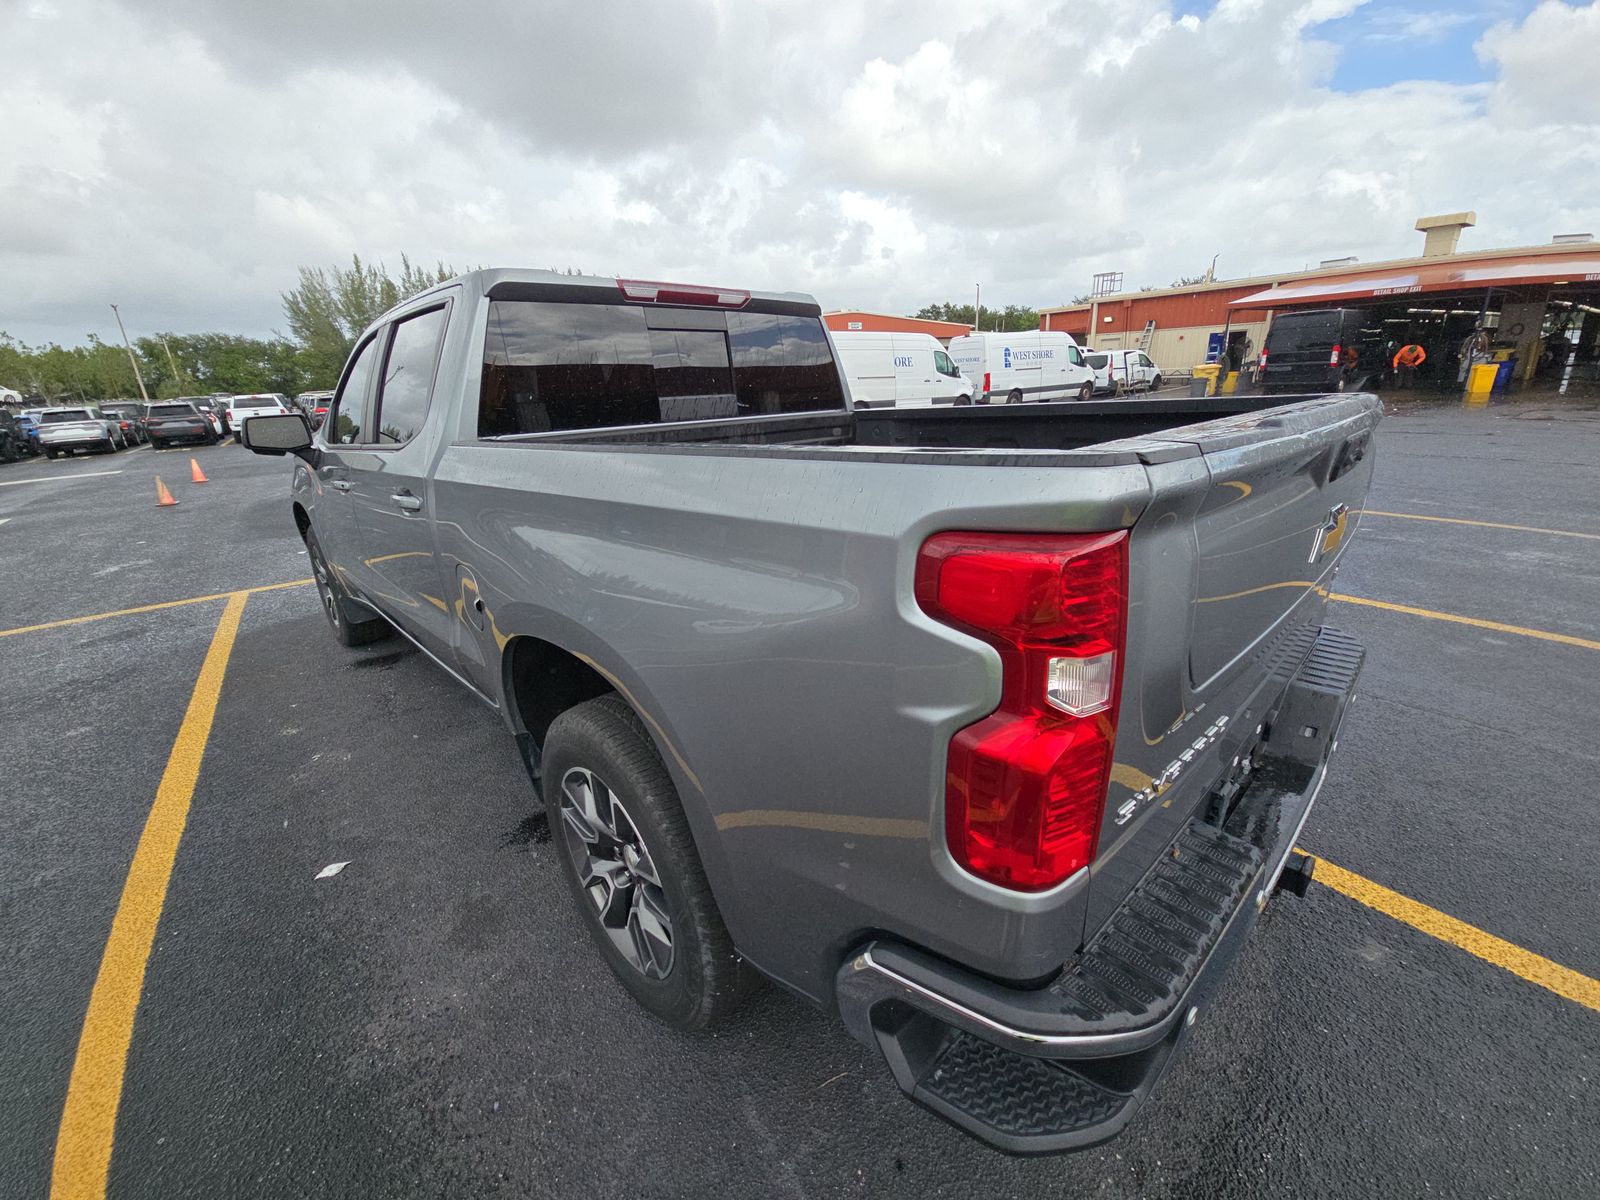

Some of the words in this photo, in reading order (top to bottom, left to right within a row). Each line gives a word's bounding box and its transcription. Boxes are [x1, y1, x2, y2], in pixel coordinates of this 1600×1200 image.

[1409, 285, 1423, 293] EXIT
[1012, 351, 1031, 361] WEST
[1031, 350, 1053, 360] SHORE
[894, 356, 913, 367] ORE
[1114, 715, 1230, 825] SILVERADO
